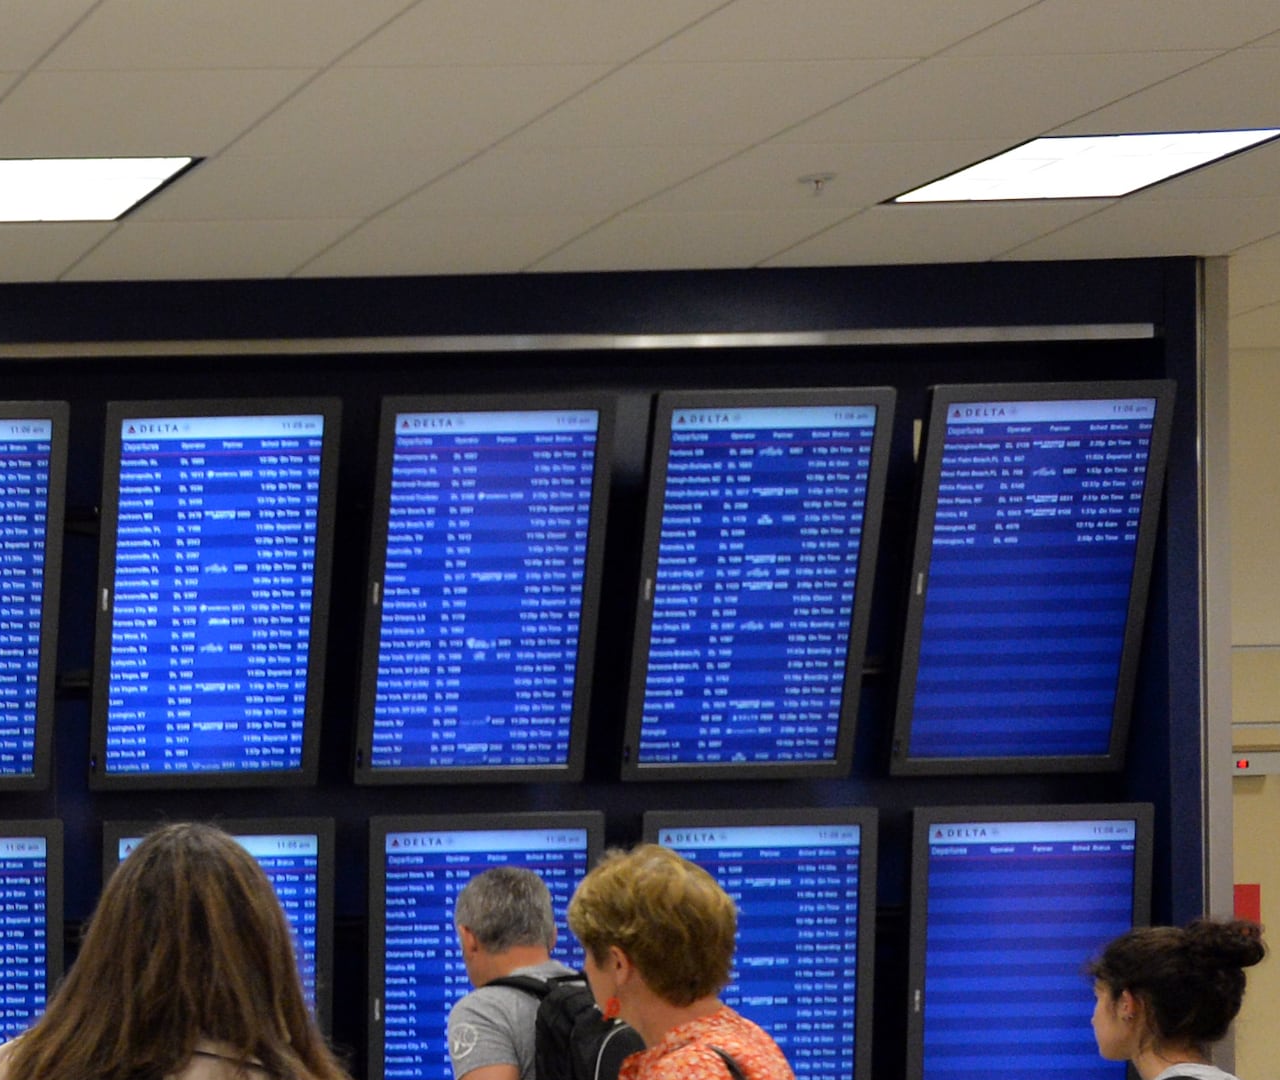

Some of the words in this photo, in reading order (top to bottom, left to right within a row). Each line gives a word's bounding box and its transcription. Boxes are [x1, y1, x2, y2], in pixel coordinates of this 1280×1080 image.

[965, 407, 1006, 417] DELTA
[414, 419, 452, 428] DELTA
[690, 415, 729, 424] DELTA
[140, 424, 179, 433] DELTA
[675, 832, 715, 842] DELTA
[948, 828, 987, 838] DELTA
[403, 837, 443, 846] DELTA
